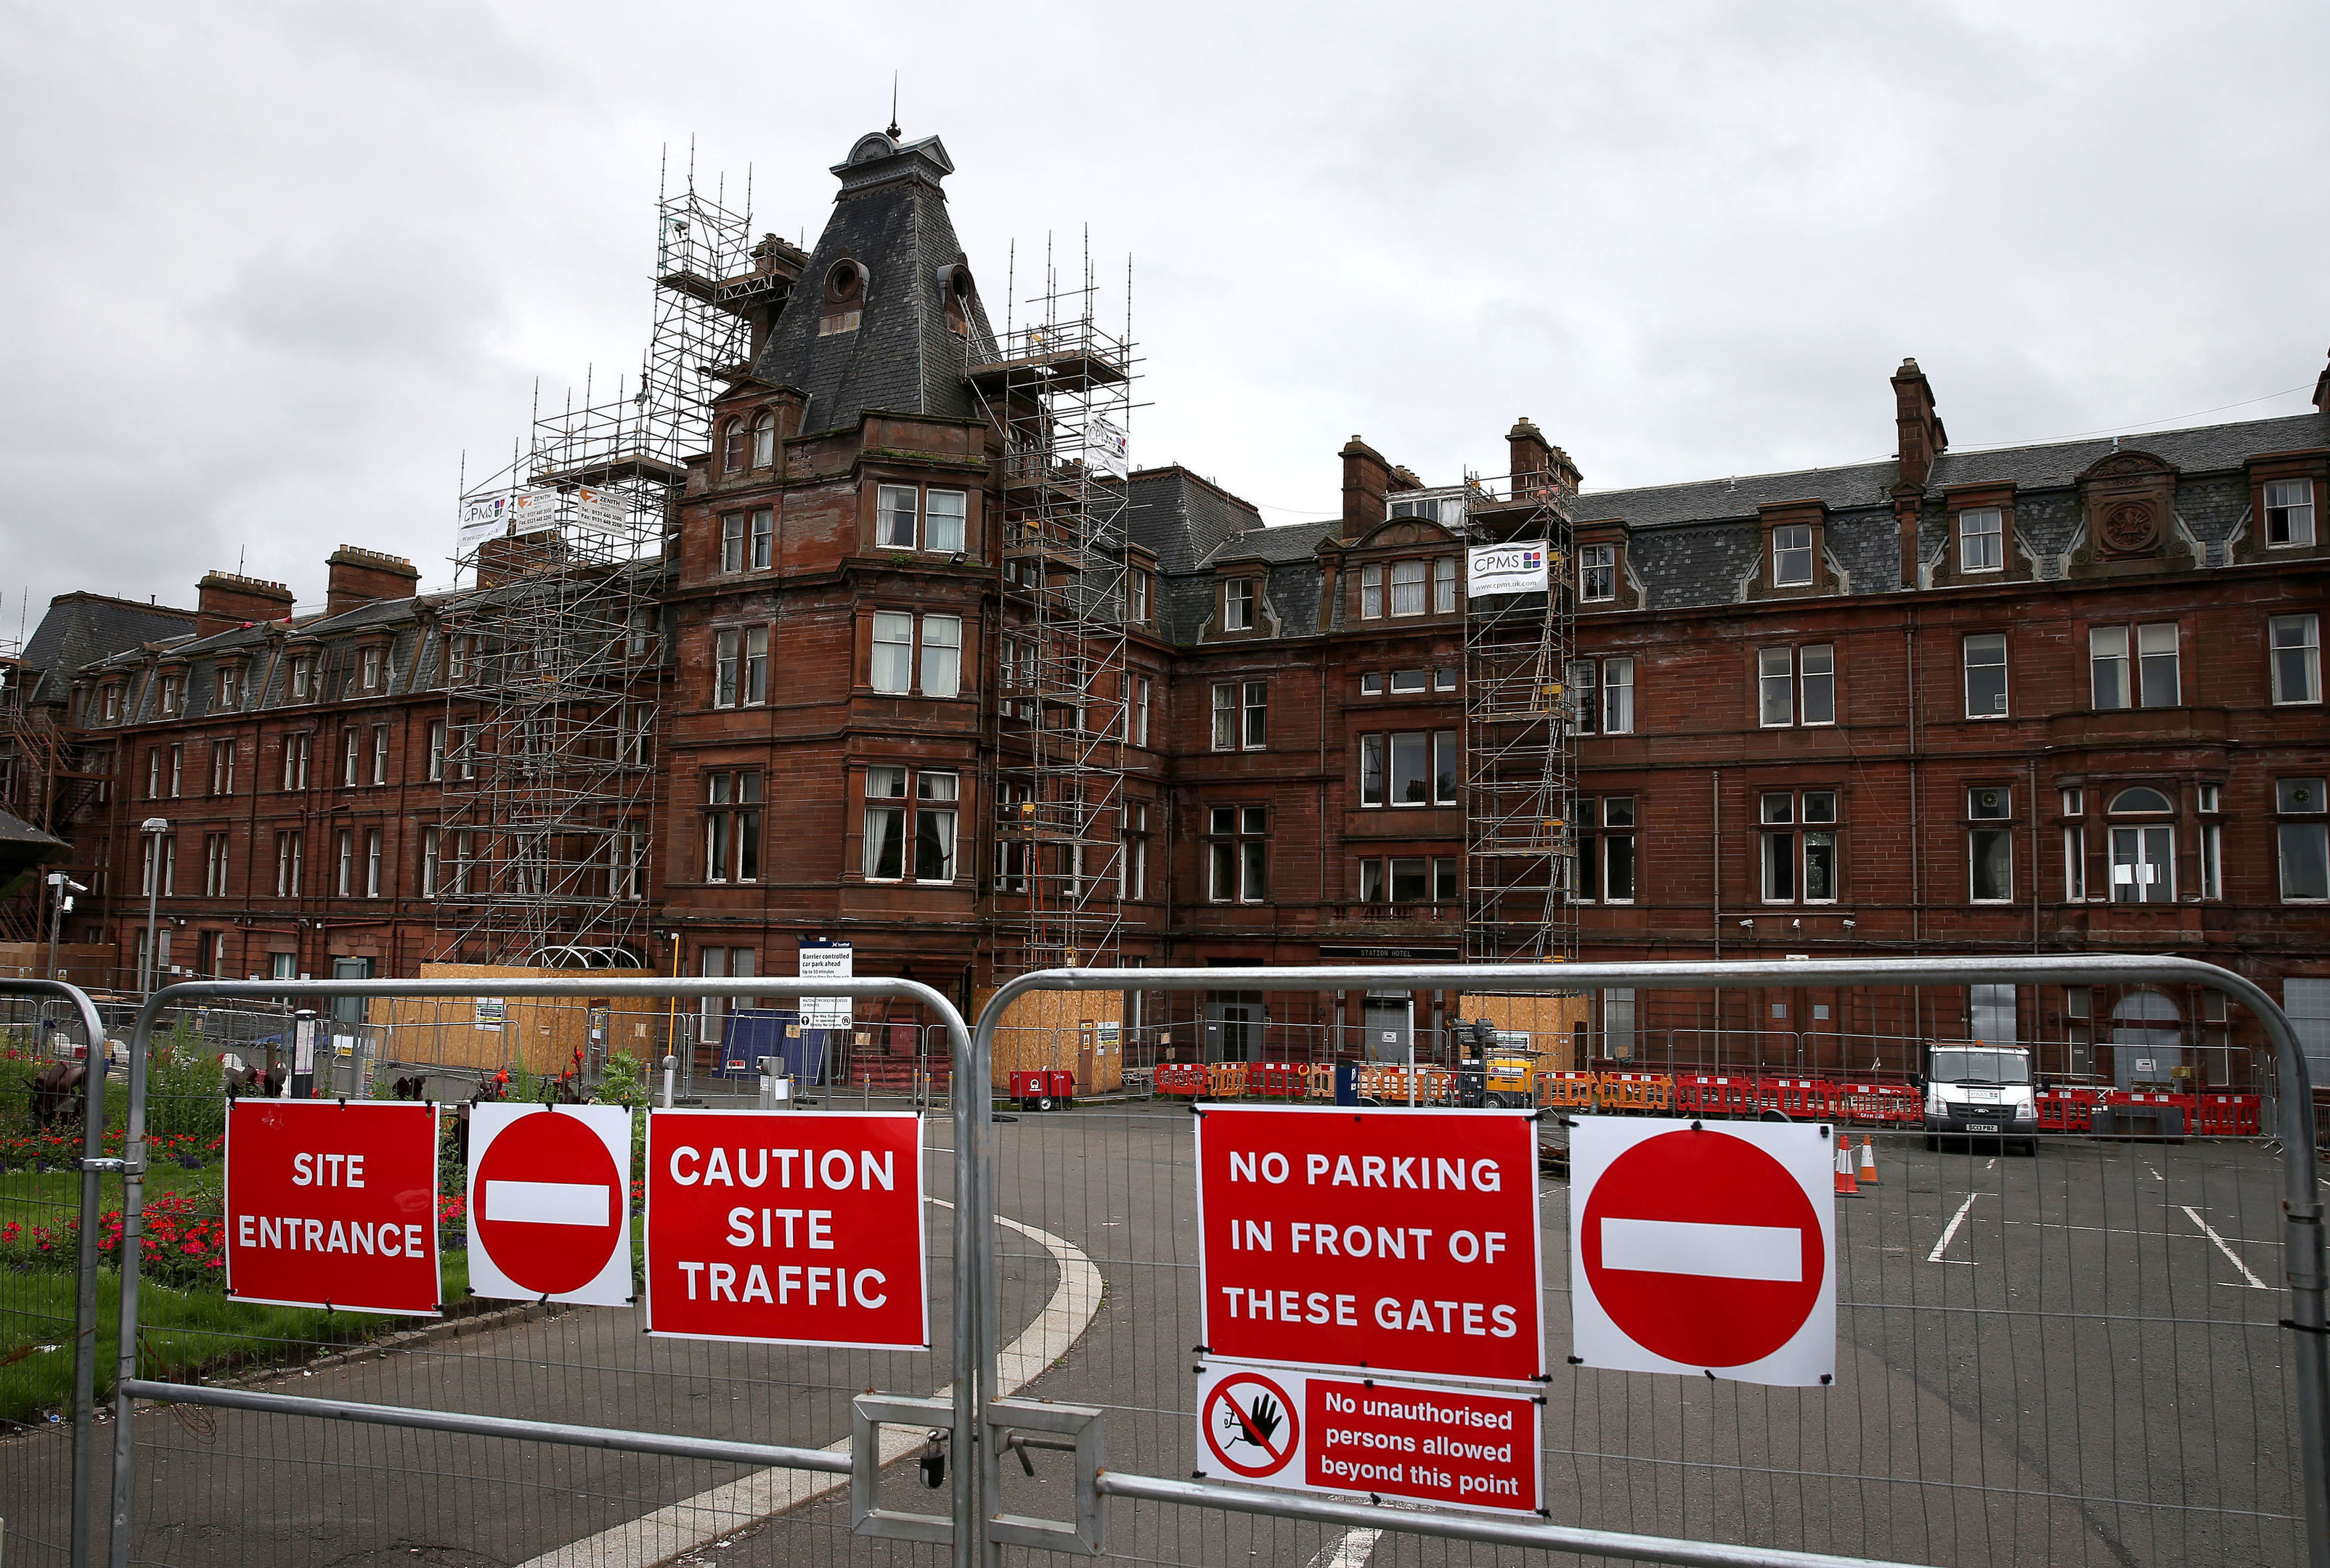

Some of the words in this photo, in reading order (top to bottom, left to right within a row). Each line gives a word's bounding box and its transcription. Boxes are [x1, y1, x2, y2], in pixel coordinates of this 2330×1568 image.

[465, 505, 492, 521] CPMS
[600, 497, 620, 506] ZENITH
[1475, 555, 1519, 571] CPMS
[1475, 581, 1537, 591] www.cpms.uk.com
[292, 1152, 364, 1188] SITE
[669, 1146, 894, 1191] CAUTION
[1229, 1151, 1290, 1184] NO
[1306, 1153, 1501, 1193] PARKING
[239, 1214, 425, 1258] ENTRANCE
[725, 1206, 834, 1250] SITE
[1231, 1219, 1273, 1251] IN
[1291, 1222, 1433, 1260] FRONT
[1449, 1230, 1507, 1264] OF
[678, 1261, 887, 1309] TRAFFIC
[1222, 1286, 1358, 1326] THESE
[1374, 1297, 1517, 1338] GATES
[1326, 1392, 1356, 1413] No
[1363, 1399, 1512, 1430] unauthorised
[1326, 1428, 1416, 1452] persons
[1422, 1434, 1511, 1463] allowed
[1321, 1454, 1403, 1482] beyond
[1409, 1465, 1452, 1488] this
[1459, 1474, 1519, 1495] point
